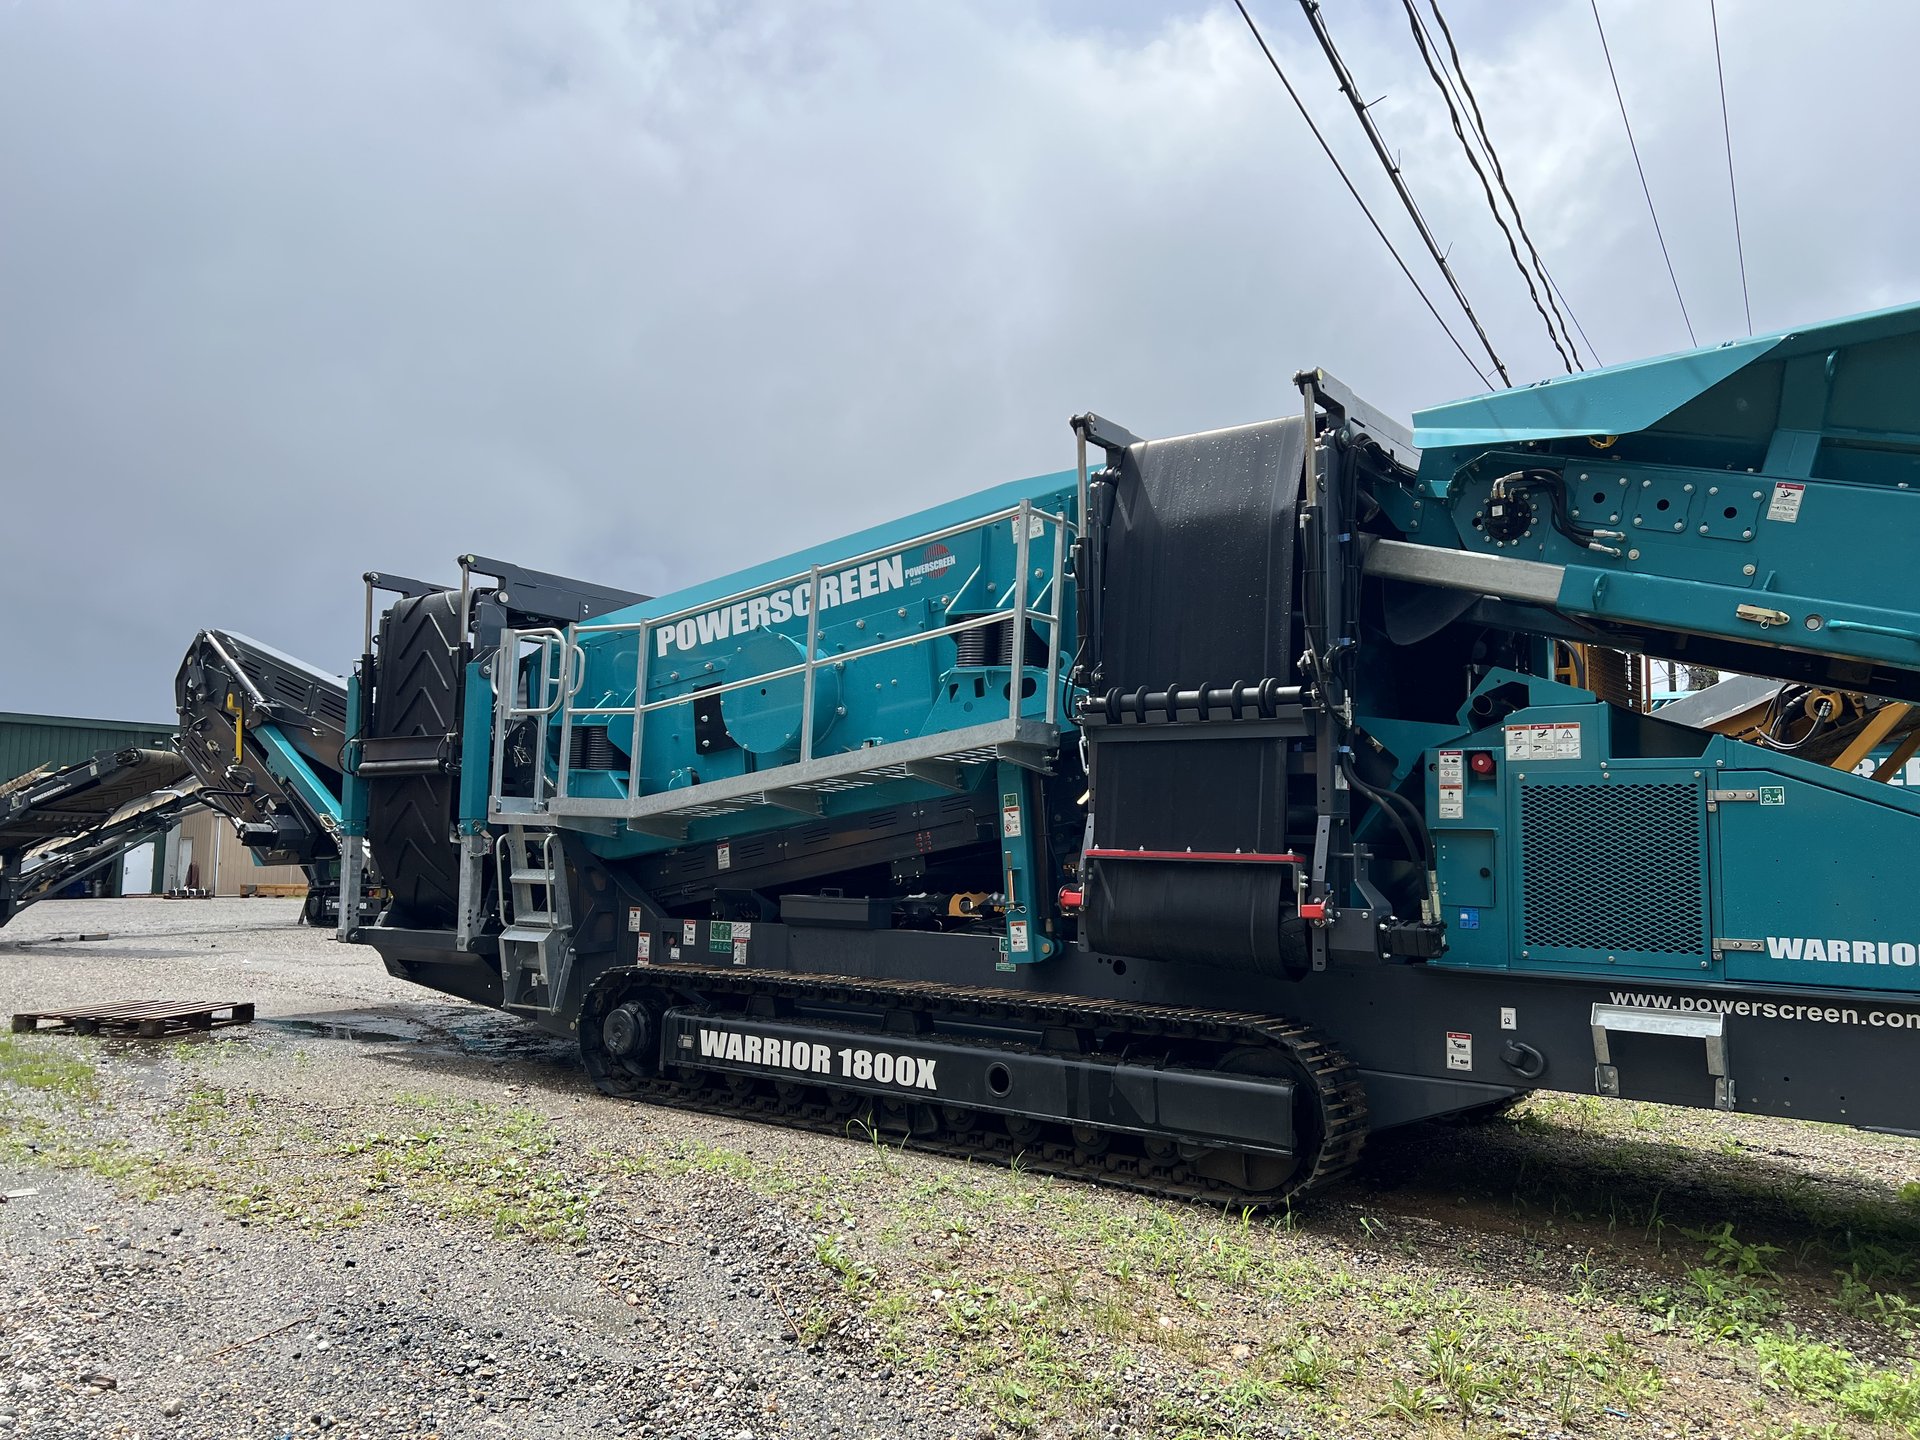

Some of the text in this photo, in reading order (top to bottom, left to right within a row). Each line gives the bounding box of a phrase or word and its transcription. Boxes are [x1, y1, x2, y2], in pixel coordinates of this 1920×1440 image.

[905, 555, 956, 579] POWERSCREEN
[656, 554, 904, 658] POWERSCREEN
[1766, 937, 1920, 967] WARRIO
[700, 1029, 937, 1090] WARRIOR 1800X
